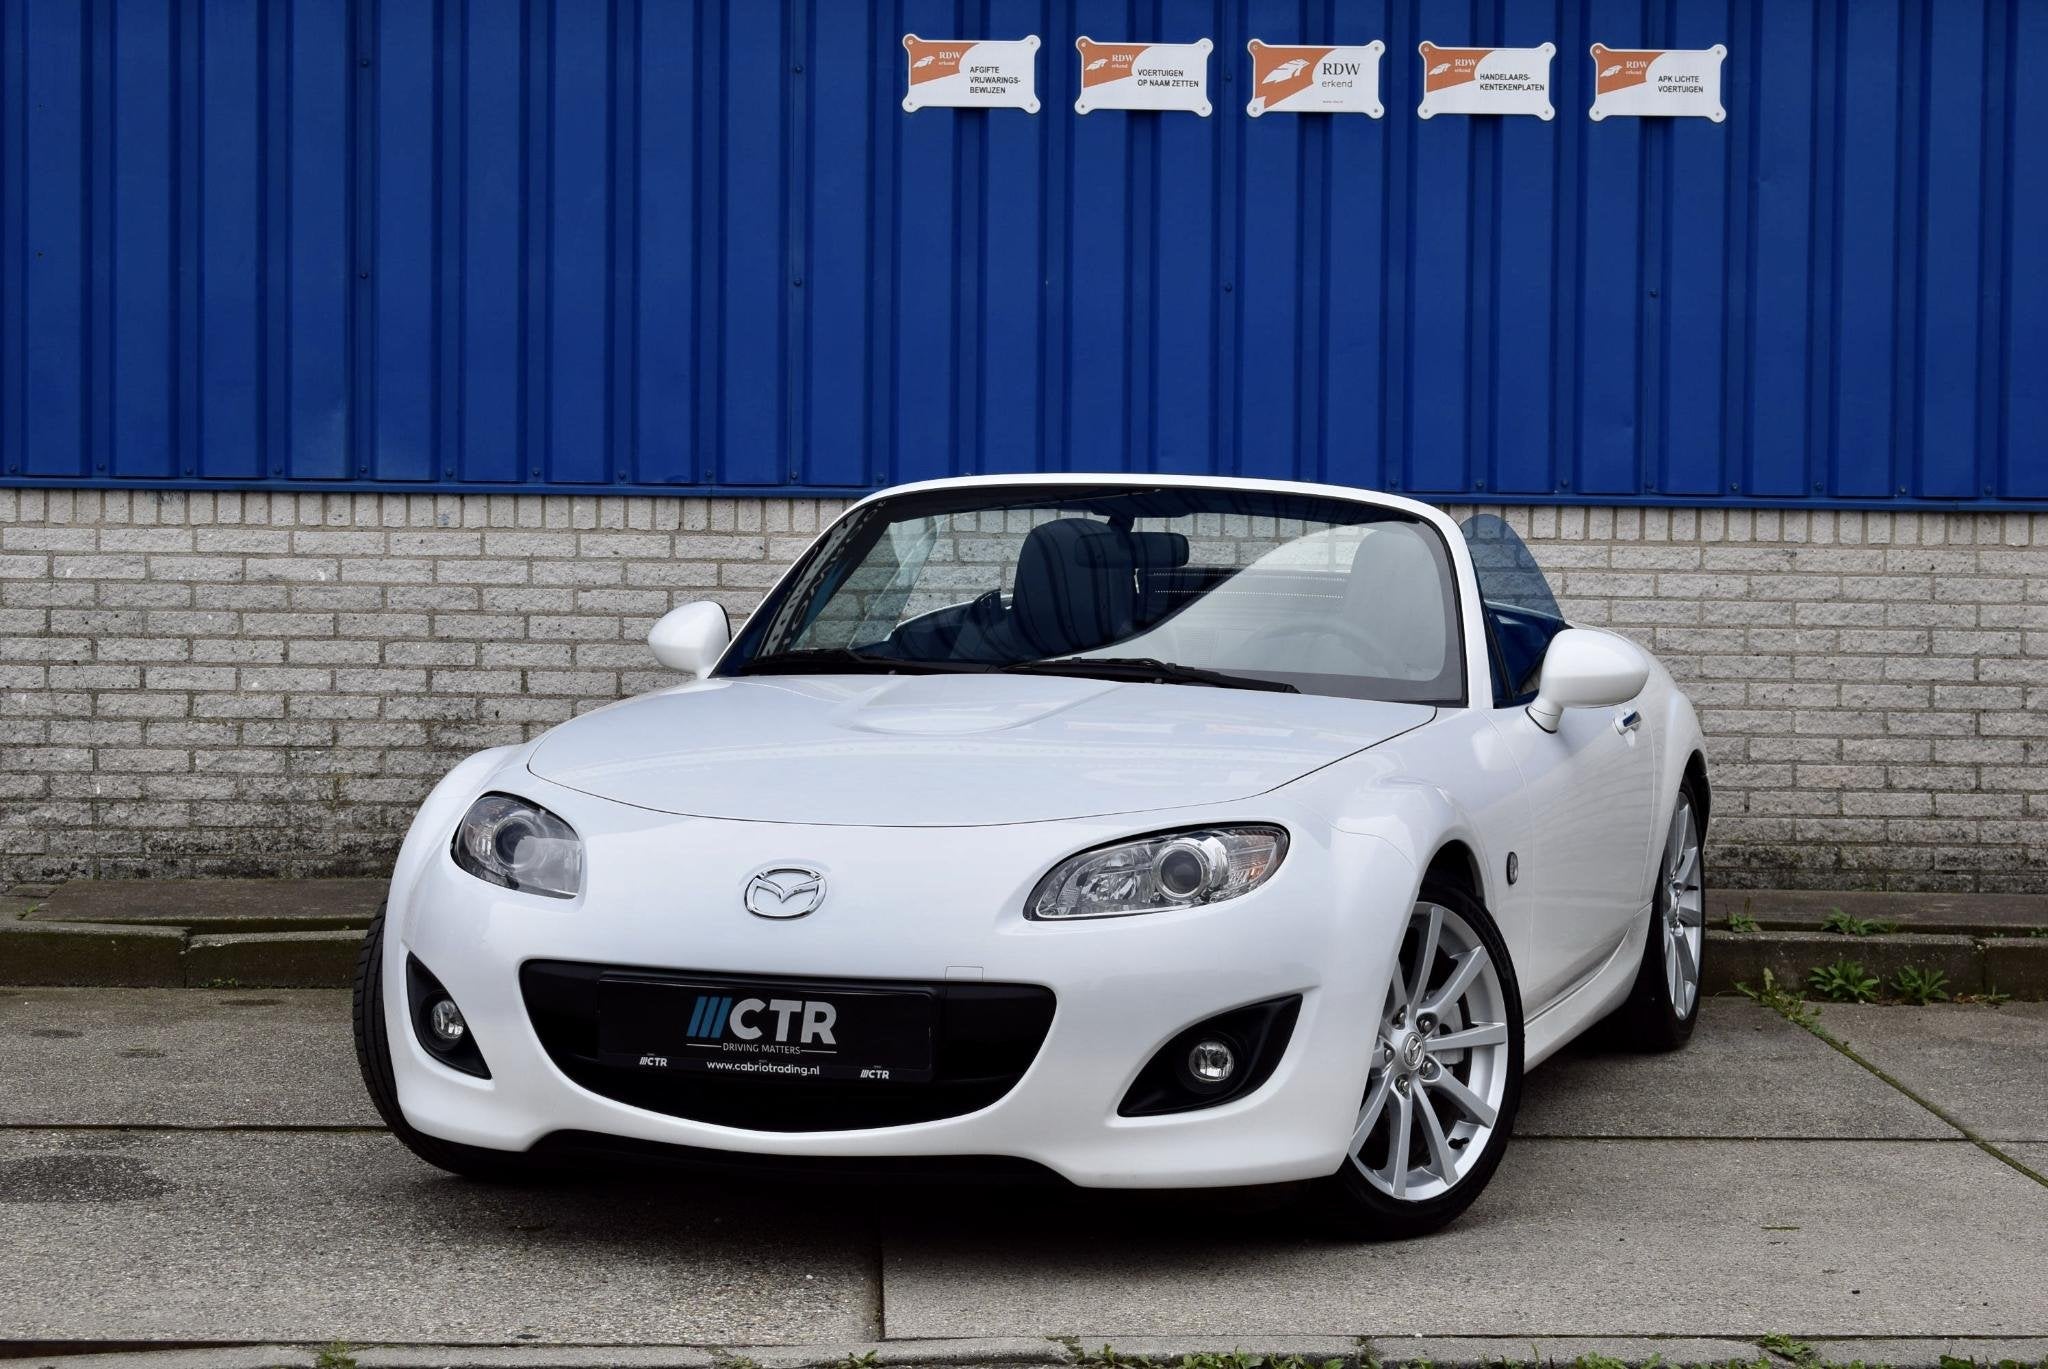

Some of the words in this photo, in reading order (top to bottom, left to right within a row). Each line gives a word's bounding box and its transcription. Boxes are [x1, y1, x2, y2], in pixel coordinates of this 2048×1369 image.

[938, 51, 961, 59] RDW
[1111, 54, 1134, 62] RDW
[1454, 58, 1477, 67] RDW
[1626, 60, 1648, 69] RDW
[969, 66, 1000, 74] AFGIFTE
[1137, 69, 1184, 77] VOERTUIGEN
[1322, 62, 1361, 75] RDW
[969, 76, 1021, 84] VRIJWARINGS-
[1479, 73, 1531, 81] HANDELAARS-
[1137, 79, 1148, 87] OP
[1149, 79, 1170, 87] NAAM
[1171, 80, 1199, 88] ZETTEN
[1321, 80, 1353, 88] erkend
[1479, 83, 1545, 91] KENTEKENPLATEN
[729, 998, 837, 1045] CTR
[722, 1042, 759, 1053] DRIVING
[761, 1044, 801, 1056] MATTERS
[647, 1057, 668, 1067] CTR
[706, 1060, 820, 1077] www.cabriotrading.nl
[868, 1069, 890, 1080] CTR
